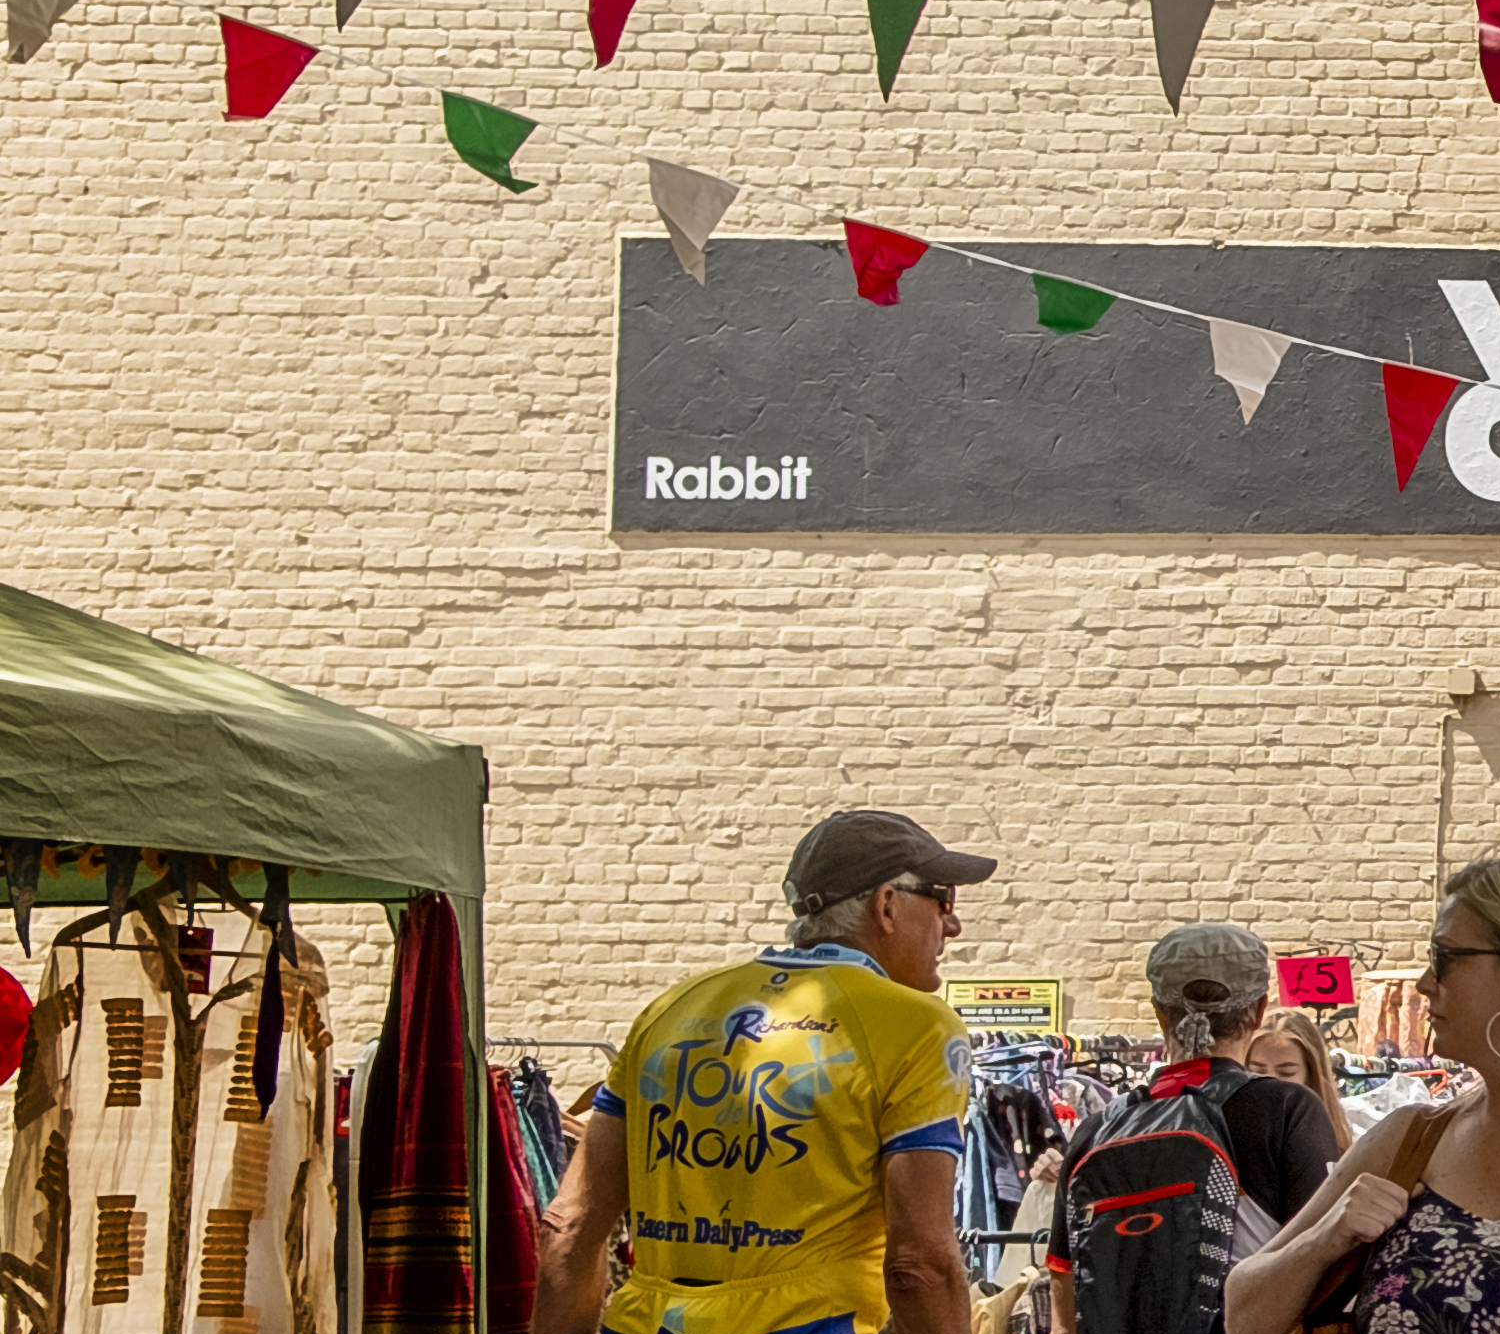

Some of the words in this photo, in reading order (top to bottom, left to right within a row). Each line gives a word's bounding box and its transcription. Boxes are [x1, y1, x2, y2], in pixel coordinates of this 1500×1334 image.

[645, 456, 812, 501] Rabbit
[975, 988, 1030, 1000] NTC
[1289, 961, 1339, 996] £5
